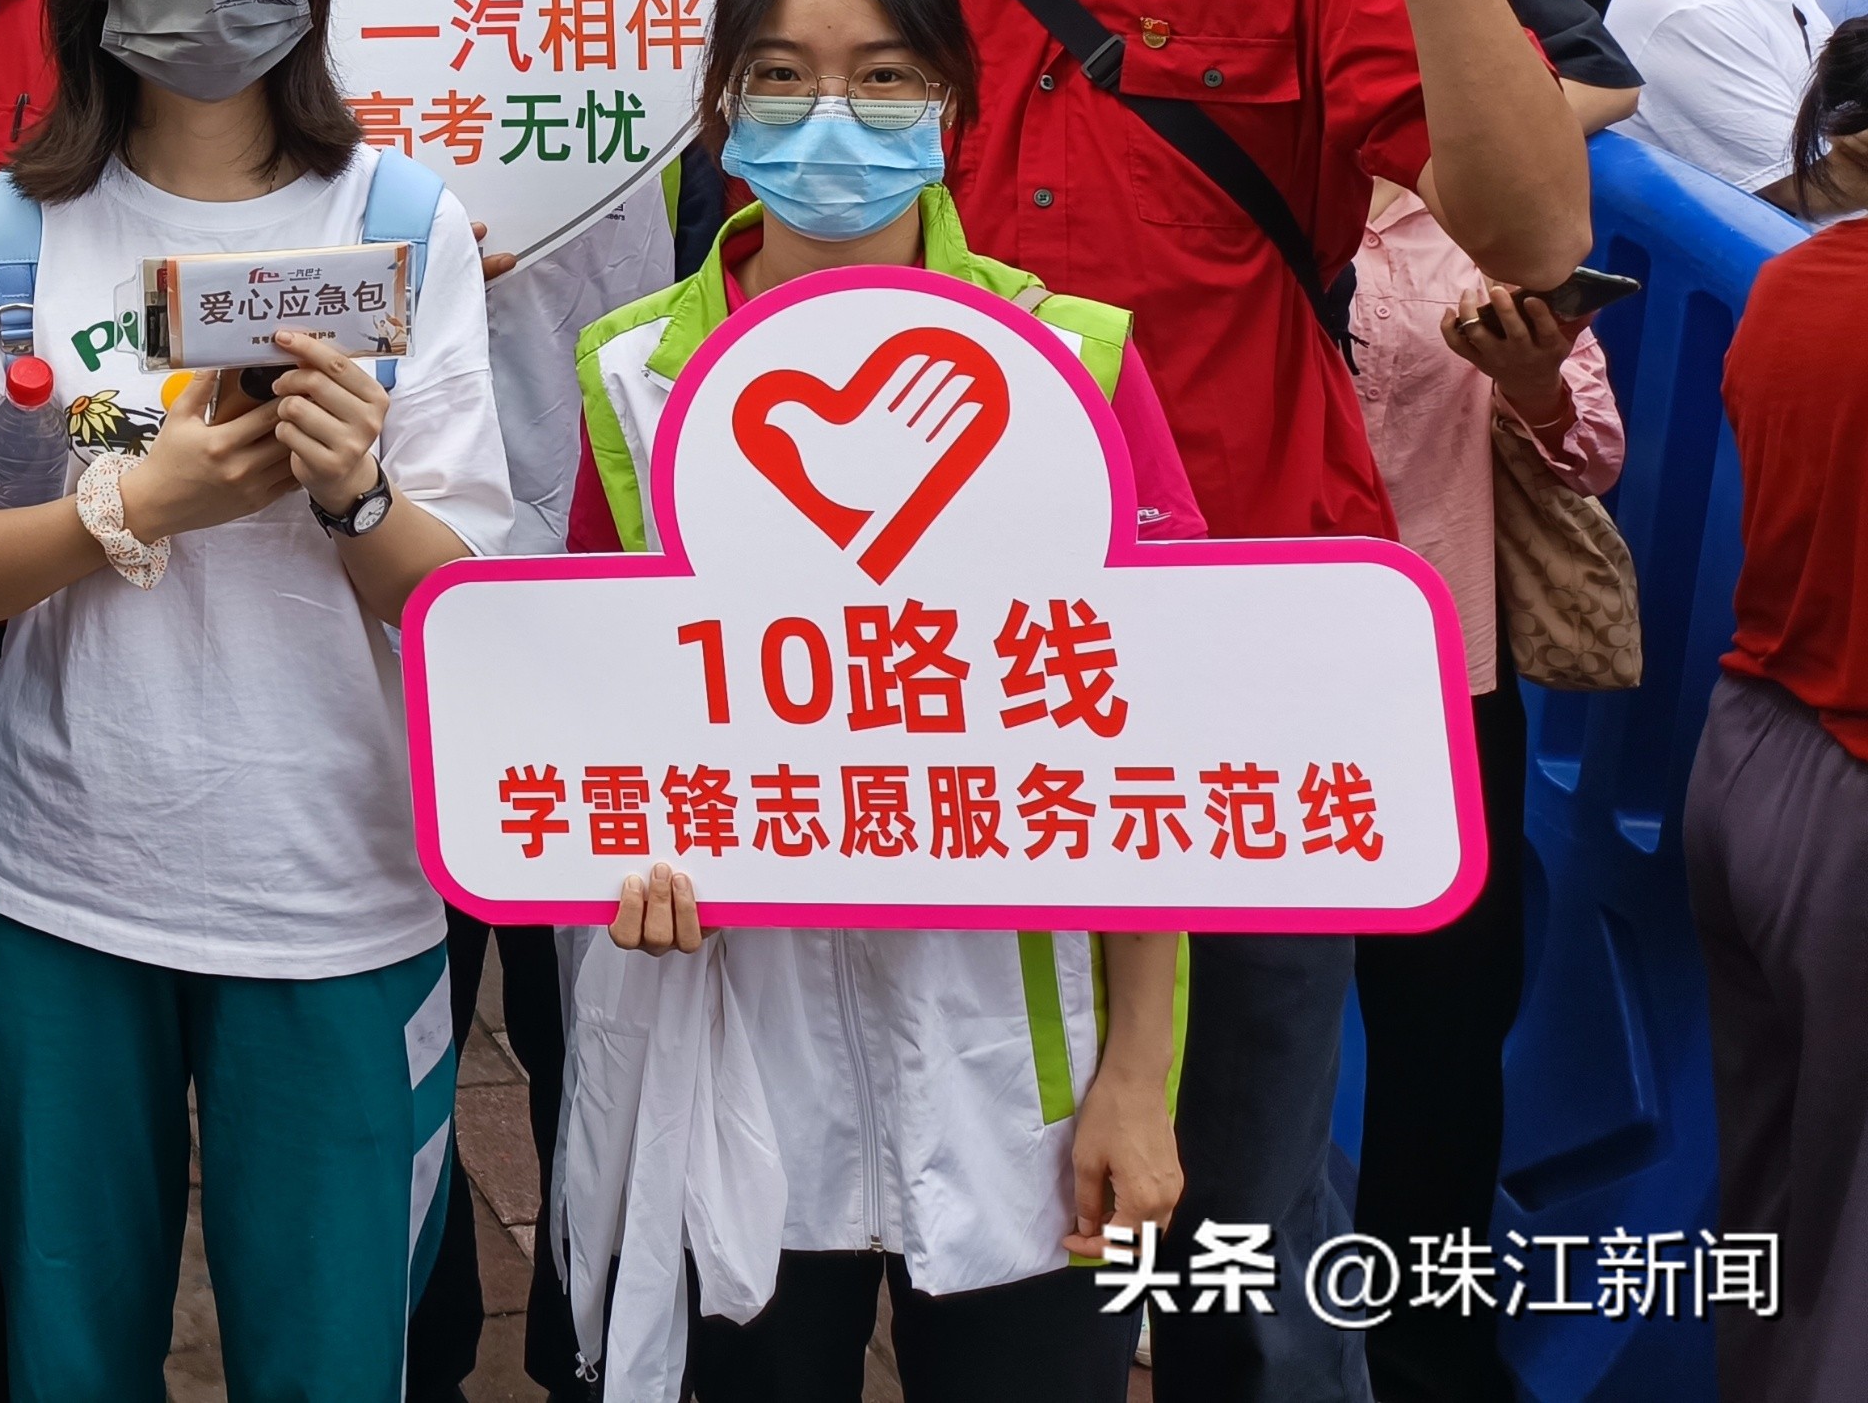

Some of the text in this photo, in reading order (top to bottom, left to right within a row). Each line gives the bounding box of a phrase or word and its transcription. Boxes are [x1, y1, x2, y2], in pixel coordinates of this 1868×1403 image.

[344, 89, 651, 165] 高考无忧
[198, 280, 387, 326] 爱心应急包
[676, 597, 1130, 739] 10路线
[497, 761, 1386, 863] 学雷锋志愿服务示范线
